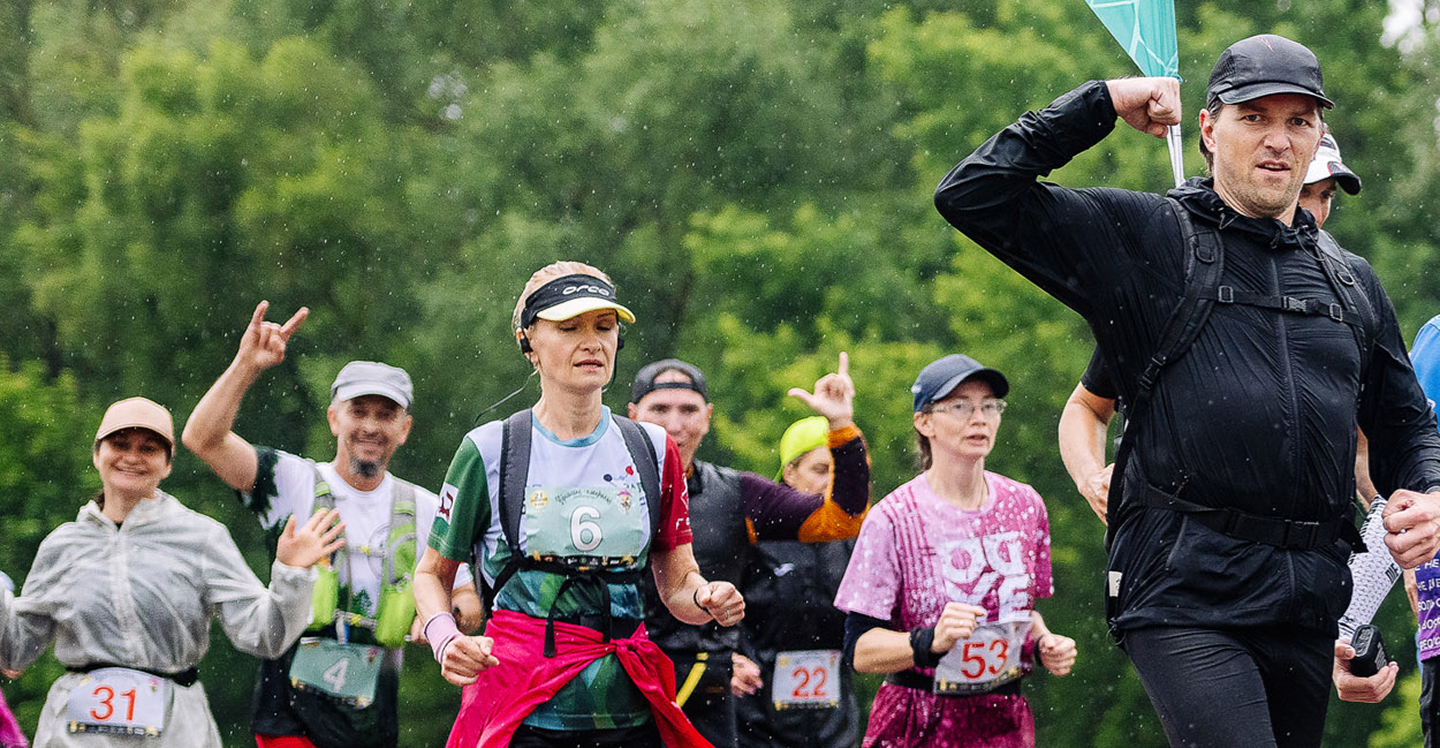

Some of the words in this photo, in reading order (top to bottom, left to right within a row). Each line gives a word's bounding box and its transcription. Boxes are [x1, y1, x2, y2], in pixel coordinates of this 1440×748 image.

[570, 505, 604, 552] 6
[322, 657, 350, 693] 4
[961, 637, 1010, 680] 53
[791, 666, 828, 698] 22
[89, 684, 137, 722] 31
